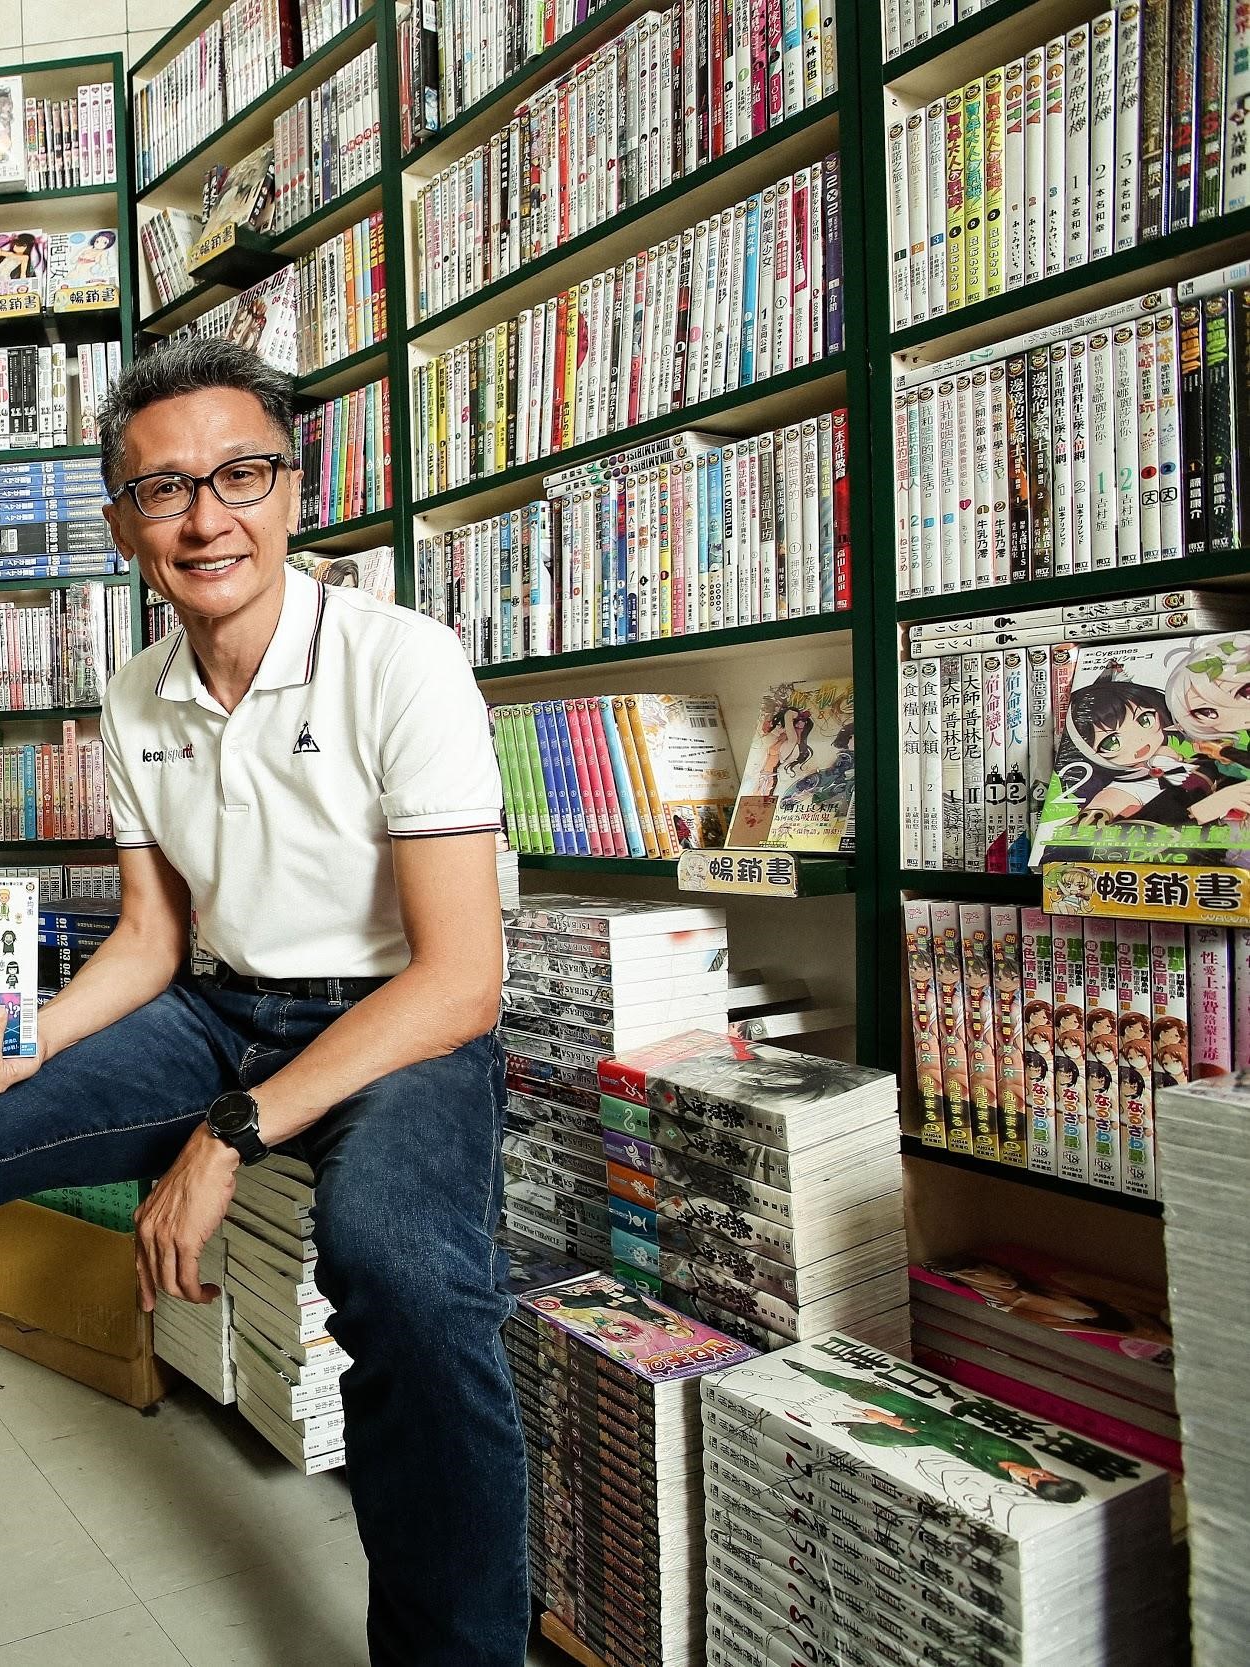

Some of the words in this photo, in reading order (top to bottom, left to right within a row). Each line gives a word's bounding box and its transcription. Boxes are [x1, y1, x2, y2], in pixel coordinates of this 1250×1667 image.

[806, 46, 817, 81] 林哲也
[1026, 75, 1042, 126] CITY
[1047, 63, 1063, 115] CITY
[1006, 84, 1022, 135] CITY
[1095, 164, 1106, 180] 2
[1120, 152, 1132, 170] 3
[1072, 176, 1079, 189] 1
[1095, 188, 1106, 233] 本名和幸
[1120, 177, 1131, 223] 本名和幸
[1071, 196, 1080, 241] 本名和幸
[200, 228, 234, 252] 暢銷書
[69, 288, 115, 304] 暢銷書
[1031, 368, 1049, 454] 邊境的老騎士
[724, 465, 732, 497] HELLO
[1058, 483, 1065, 496] 1
[1074, 480, 1085, 494] 2
[1096, 471, 1105, 494] 1
[1120, 467, 1133, 492] 2
[725, 550, 732, 566] 1
[1095, 647, 1138, 657] Cygames
[903, 682, 920, 755] 食糧人類
[922, 681, 939, 755] 食糧人類
[942, 677, 961, 761] 大師普林尼
[963, 674, 982, 759] 大師普林尼
[985, 674, 1001, 750] 宿命戀人
[1006, 672, 1022, 750] 宿命戀人
[989, 785, 998, 799] 1
[1009, 785, 1020, 799] 2
[1036, 788, 1045, 799] 2
[1053, 762, 1094, 804] 2
[966, 787, 980, 804] II
[1092, 849, 1188, 865] Re:Dive
[709, 856, 792, 886] 暢銷書
[1096, 871, 1241, 910] 暢銷書
[59, 917, 68, 929] 01
[59, 934, 69, 947] 02
[62, 948, 71, 961] 03
[63, 963, 71, 976] 04
[563, 983, 595, 997] TSUBASA
[560, 1049, 597, 1065] TSUBASA
